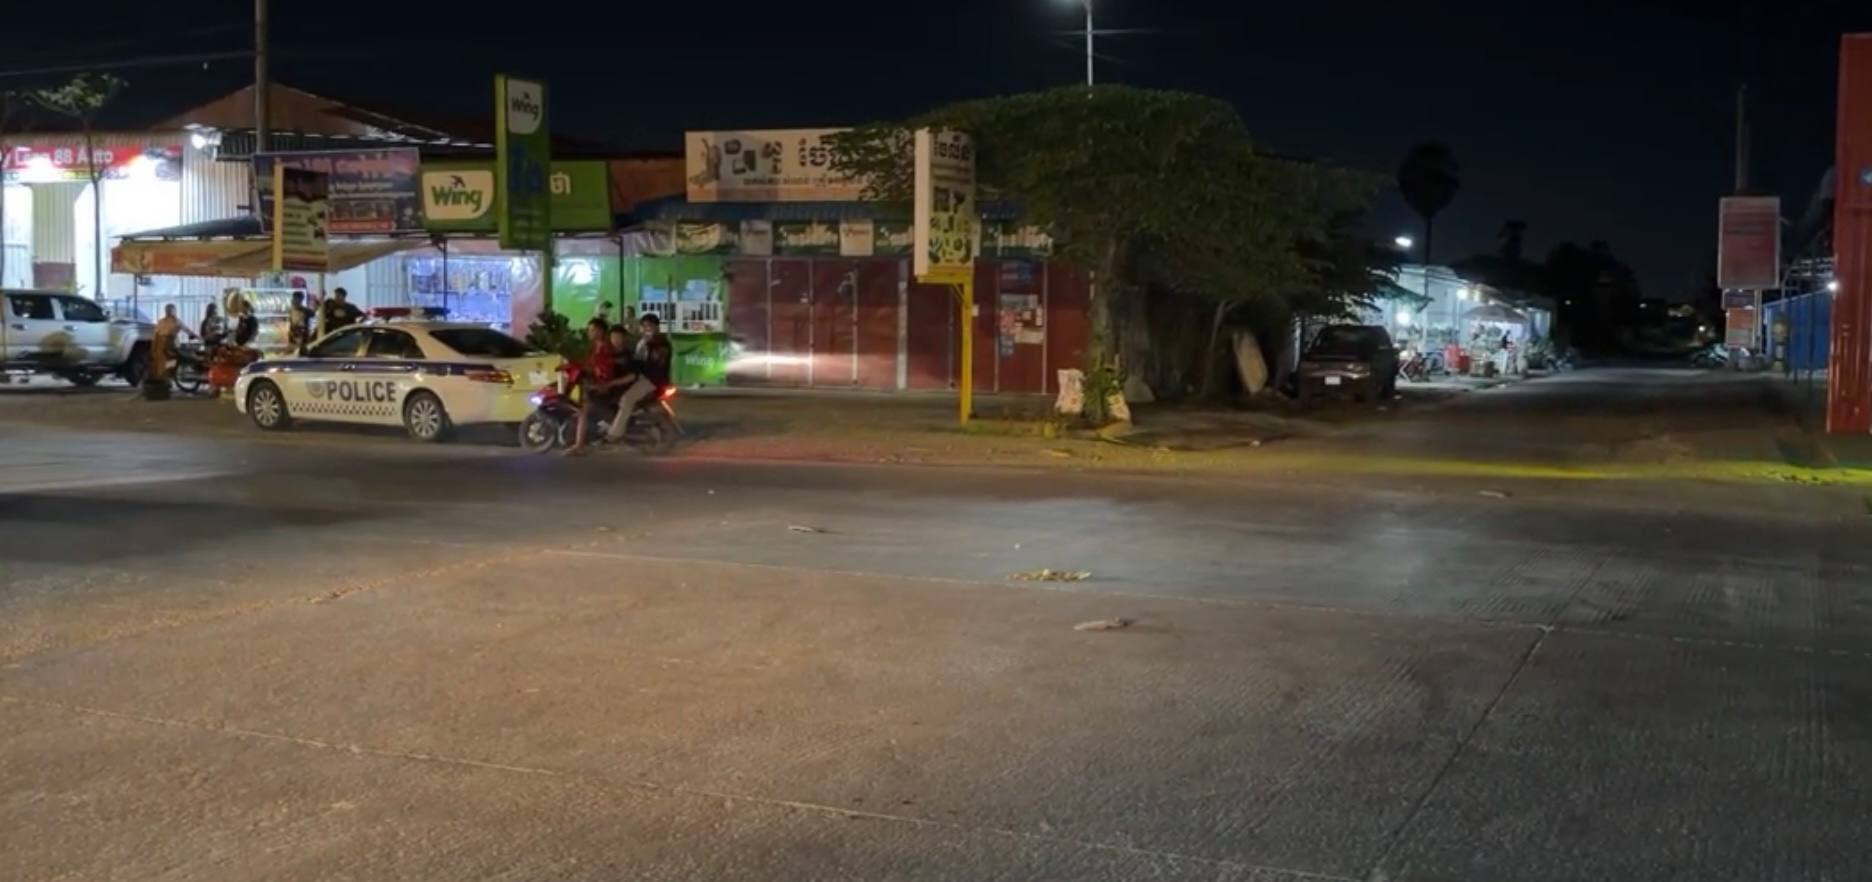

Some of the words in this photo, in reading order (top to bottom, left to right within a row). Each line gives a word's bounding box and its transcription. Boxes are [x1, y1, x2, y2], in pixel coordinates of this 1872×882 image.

[512, 98, 540, 120] Wing
[55, 149, 74, 166] 88
[432, 187, 483, 212] Wing
[326, 381, 397, 402] POLICE
